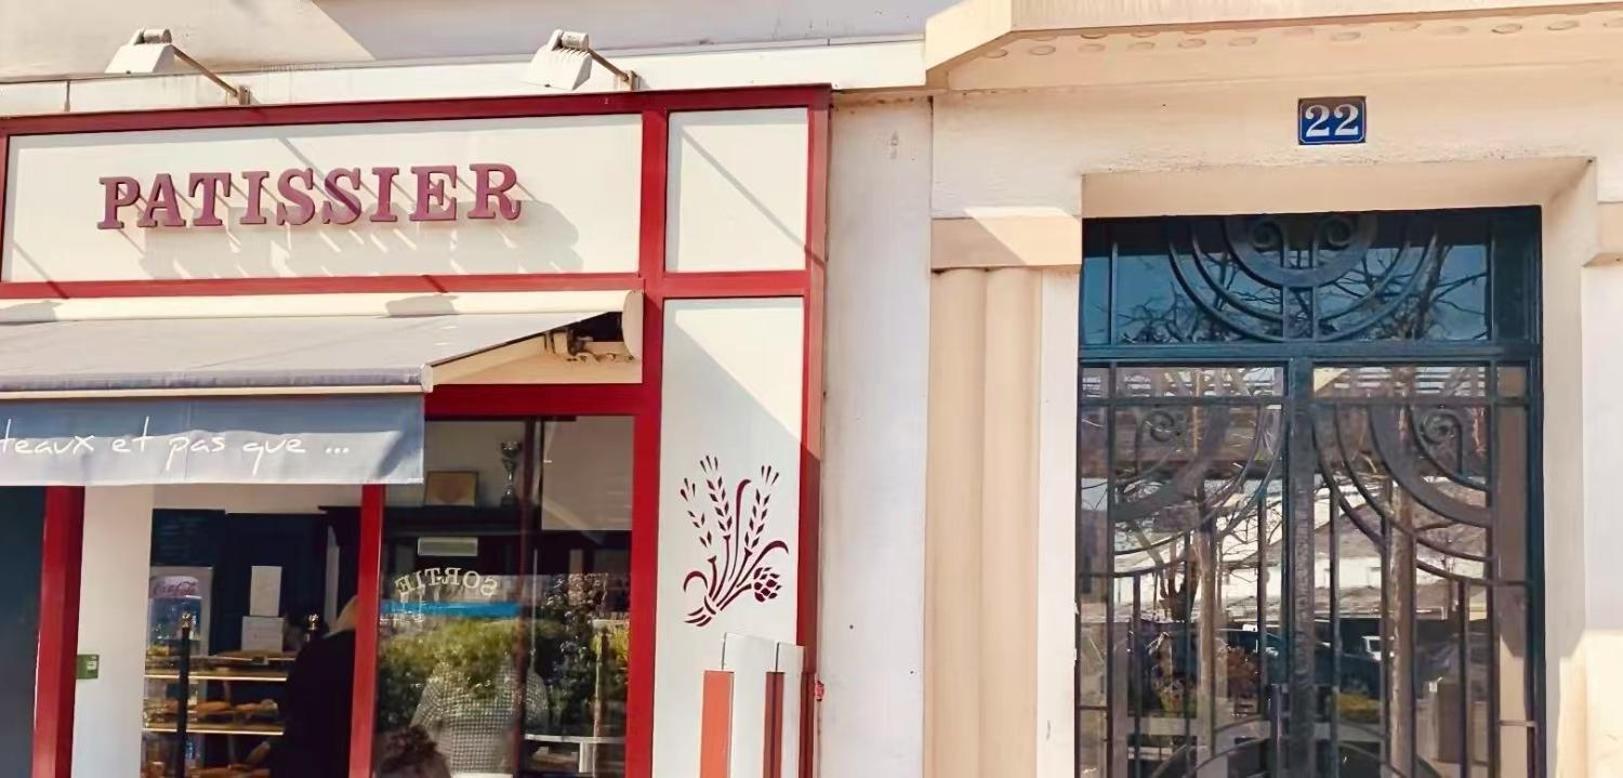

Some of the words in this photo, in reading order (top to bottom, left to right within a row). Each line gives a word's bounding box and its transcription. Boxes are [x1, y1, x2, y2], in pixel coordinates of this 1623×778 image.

[1304, 103, 1359, 137] 22
[97, 163, 521, 230] PATISSIER
[0, 418, 95, 455] teaux
[112, 416, 150, 454] et
[166, 437, 226, 471] pas
[243, 437, 306, 476] que
